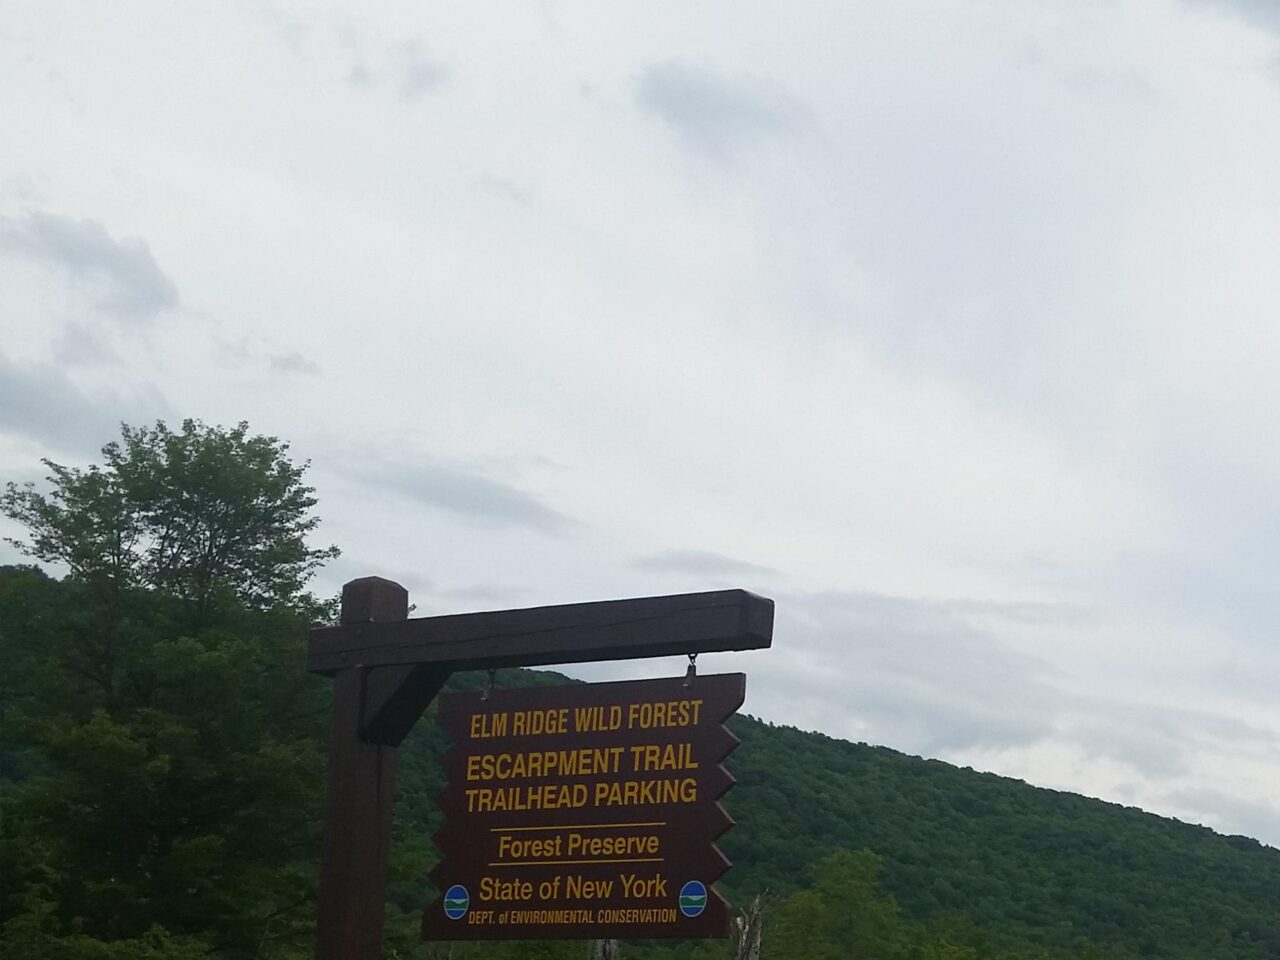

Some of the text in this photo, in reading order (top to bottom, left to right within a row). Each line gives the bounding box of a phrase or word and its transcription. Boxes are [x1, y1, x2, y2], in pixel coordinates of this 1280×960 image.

[470, 700, 703, 738] ELM RIDGE WILD FOREST
[467, 743, 699, 781] ESCARPMENT TRAIL
[465, 777, 698, 813] TRAILHEAD PARKING
[499, 832, 660, 858] Forest Preserve
[479, 873, 668, 902] State of New York
[468, 908, 677, 925] DEPT. of ENVIRONMENTAL CONSERVATION
